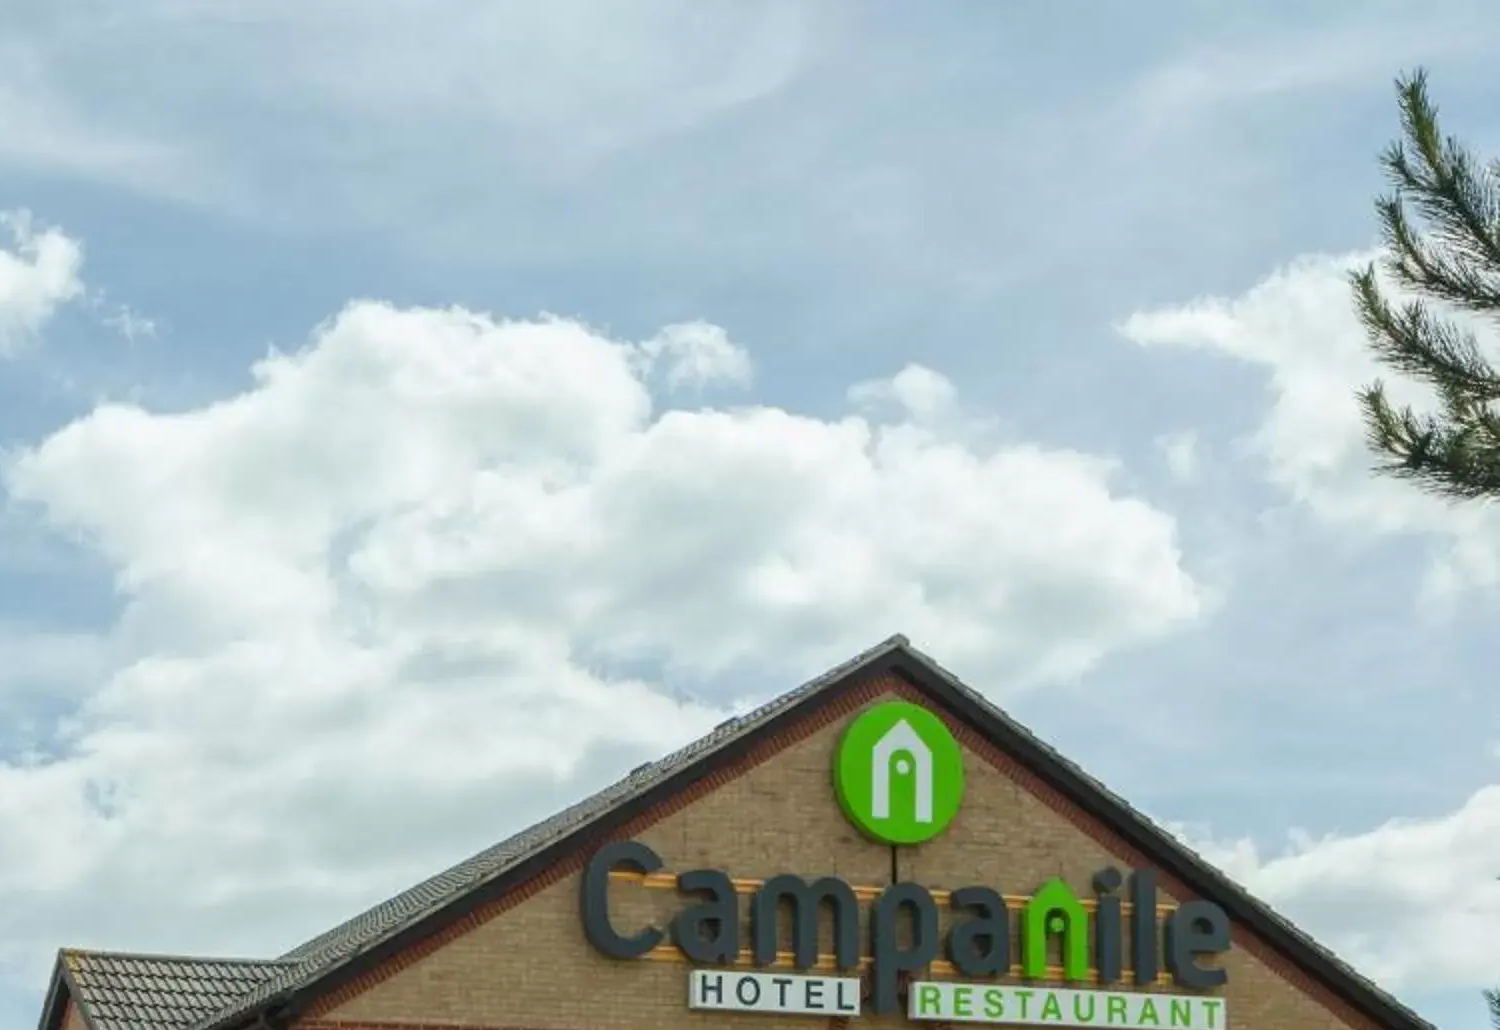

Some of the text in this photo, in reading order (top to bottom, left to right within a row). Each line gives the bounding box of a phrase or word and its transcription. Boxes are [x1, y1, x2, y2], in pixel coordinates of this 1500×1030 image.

[582, 840, 1232, 1014] Campanile
[700, 974, 856, 1011] HOTEL
[918, 985, 1222, 1030] RESTAURANT
